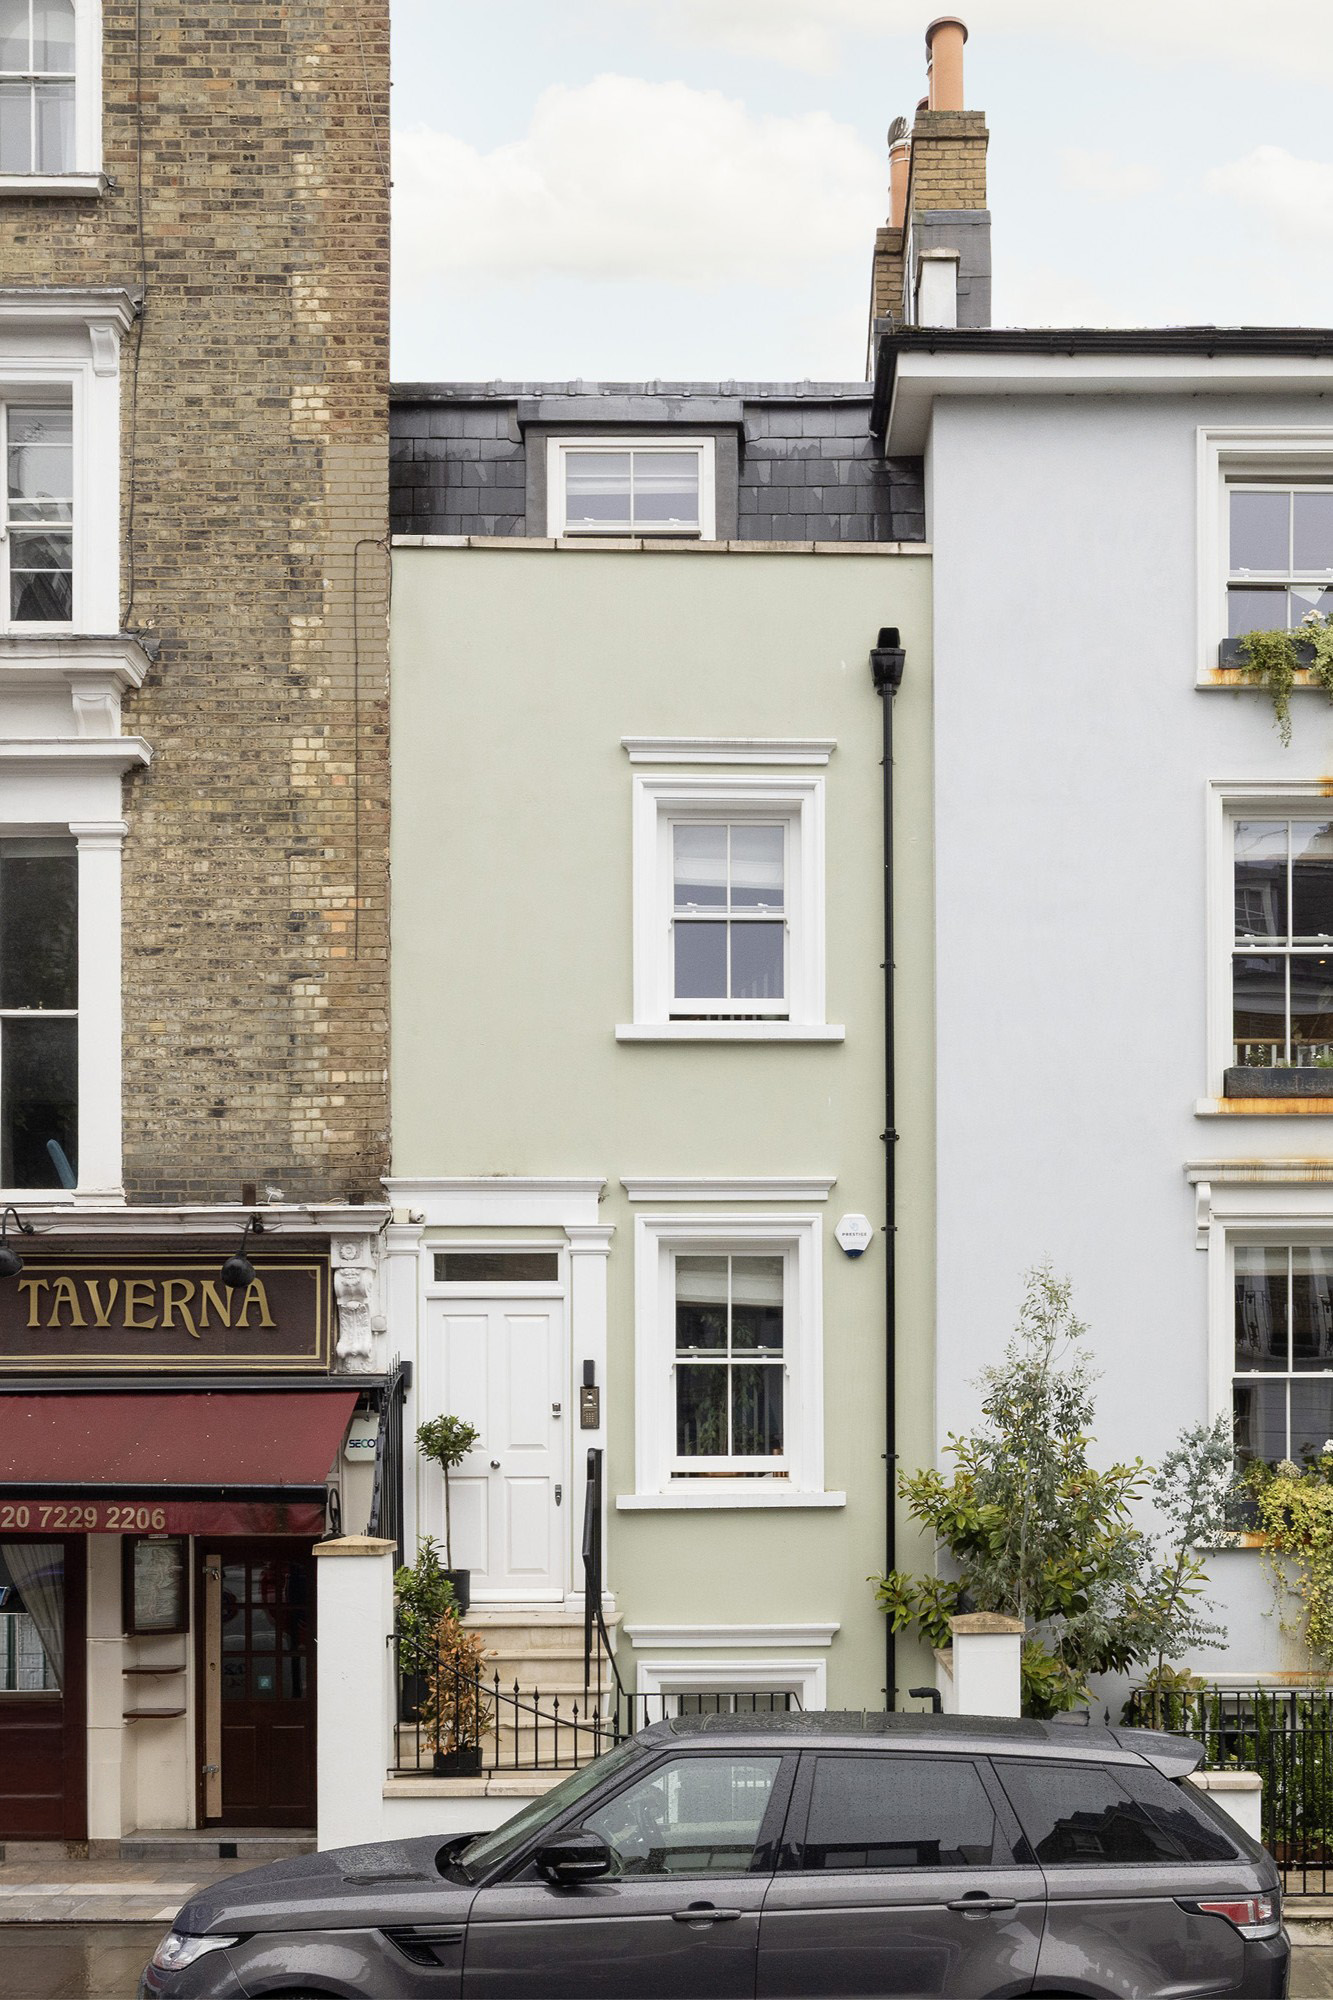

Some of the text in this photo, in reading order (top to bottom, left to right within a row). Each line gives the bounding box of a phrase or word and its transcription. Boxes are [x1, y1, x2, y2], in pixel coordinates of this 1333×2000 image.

[18, 1276, 277, 1338] TAVERNA
[348, 1438, 377, 1448] SECO
[1, 1506, 166, 1530] 20 7229 2206
